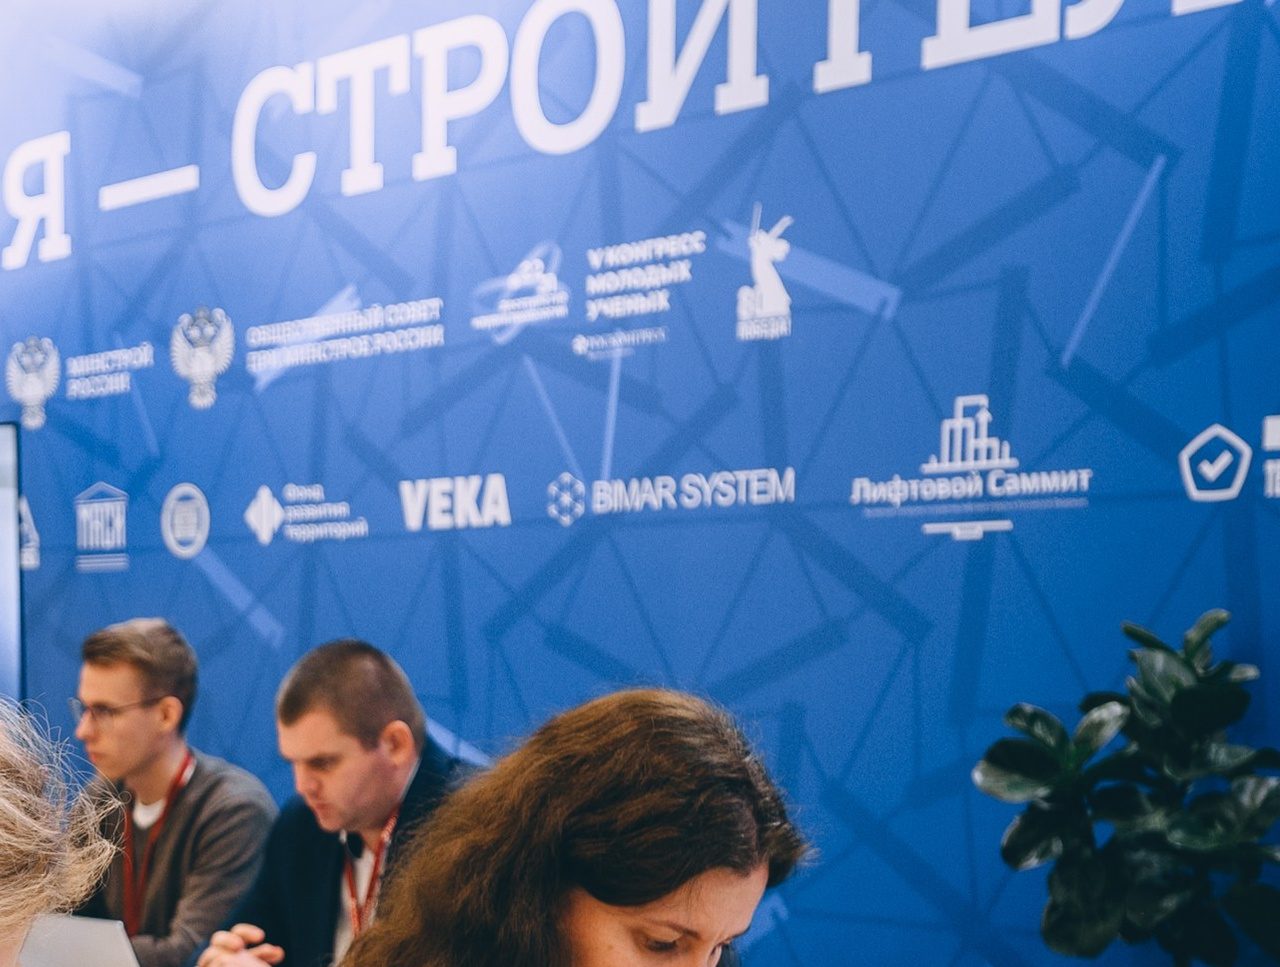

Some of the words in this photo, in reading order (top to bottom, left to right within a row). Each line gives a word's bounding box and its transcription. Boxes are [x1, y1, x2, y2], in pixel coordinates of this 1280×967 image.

[2, 130, 71, 270] Я
[231, 0, 1250, 218] СТРОИТ
[604, 230, 706, 269] КОНГРЕСС
[585, 258, 692, 296] МОЛОДЫХ
[384, 297, 444, 327] СОВЕТ
[399, 472, 512, 532] VEKA
[591, 474, 678, 515] BIMAR
[679, 466, 795, 509] SYSTEM
[850, 470, 984, 508] Лифтовой
[986, 468, 1094, 498] Саммит
